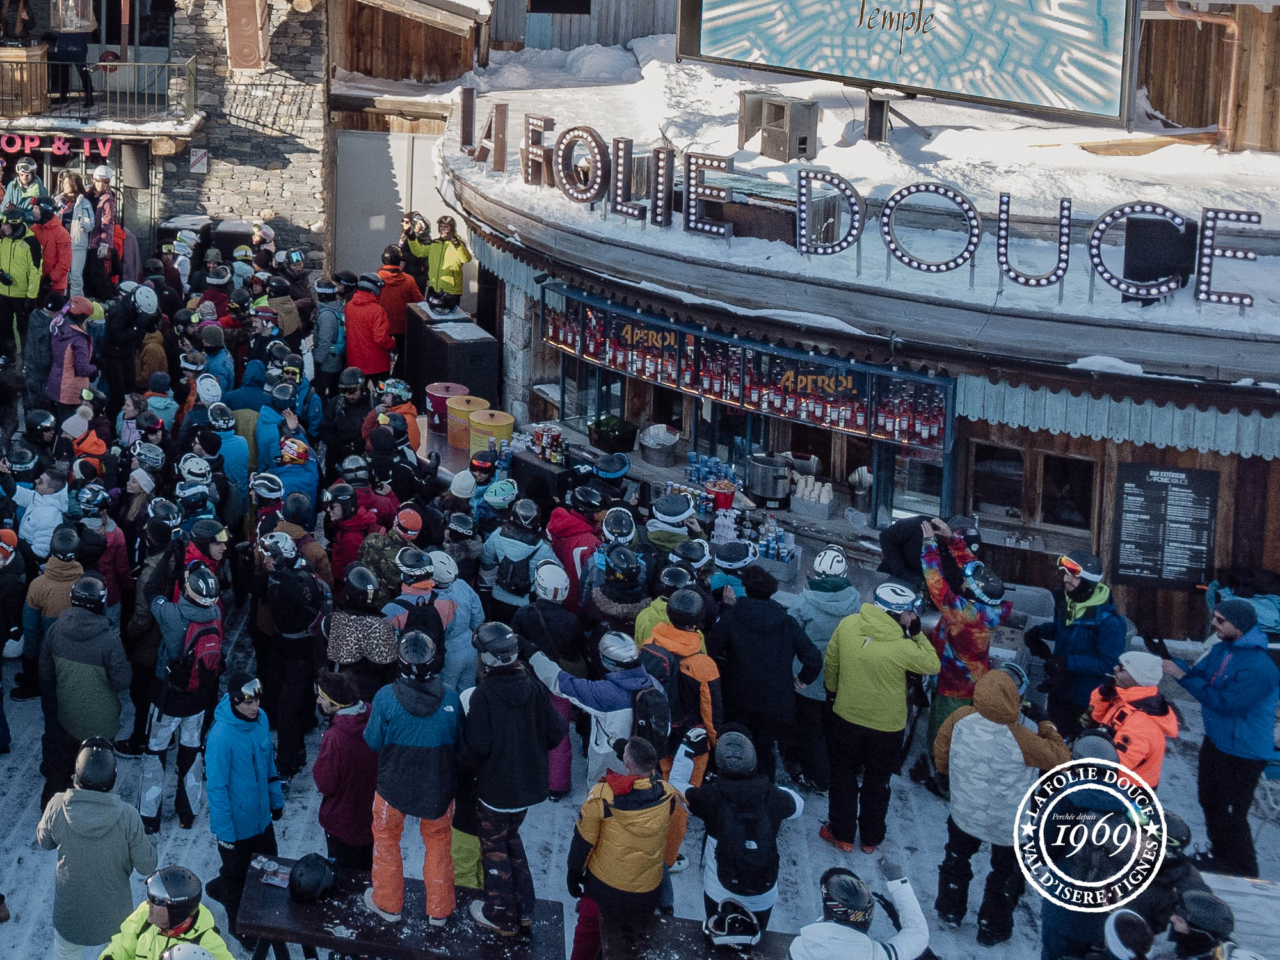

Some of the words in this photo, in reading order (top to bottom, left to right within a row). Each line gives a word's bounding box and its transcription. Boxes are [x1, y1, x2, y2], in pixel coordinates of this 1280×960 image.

[52, 135, 70, 155] &
[82, 137, 113, 157] TV
[524, 112, 734, 238] FOLIE
[796, 168, 1262, 308] DOUCE
